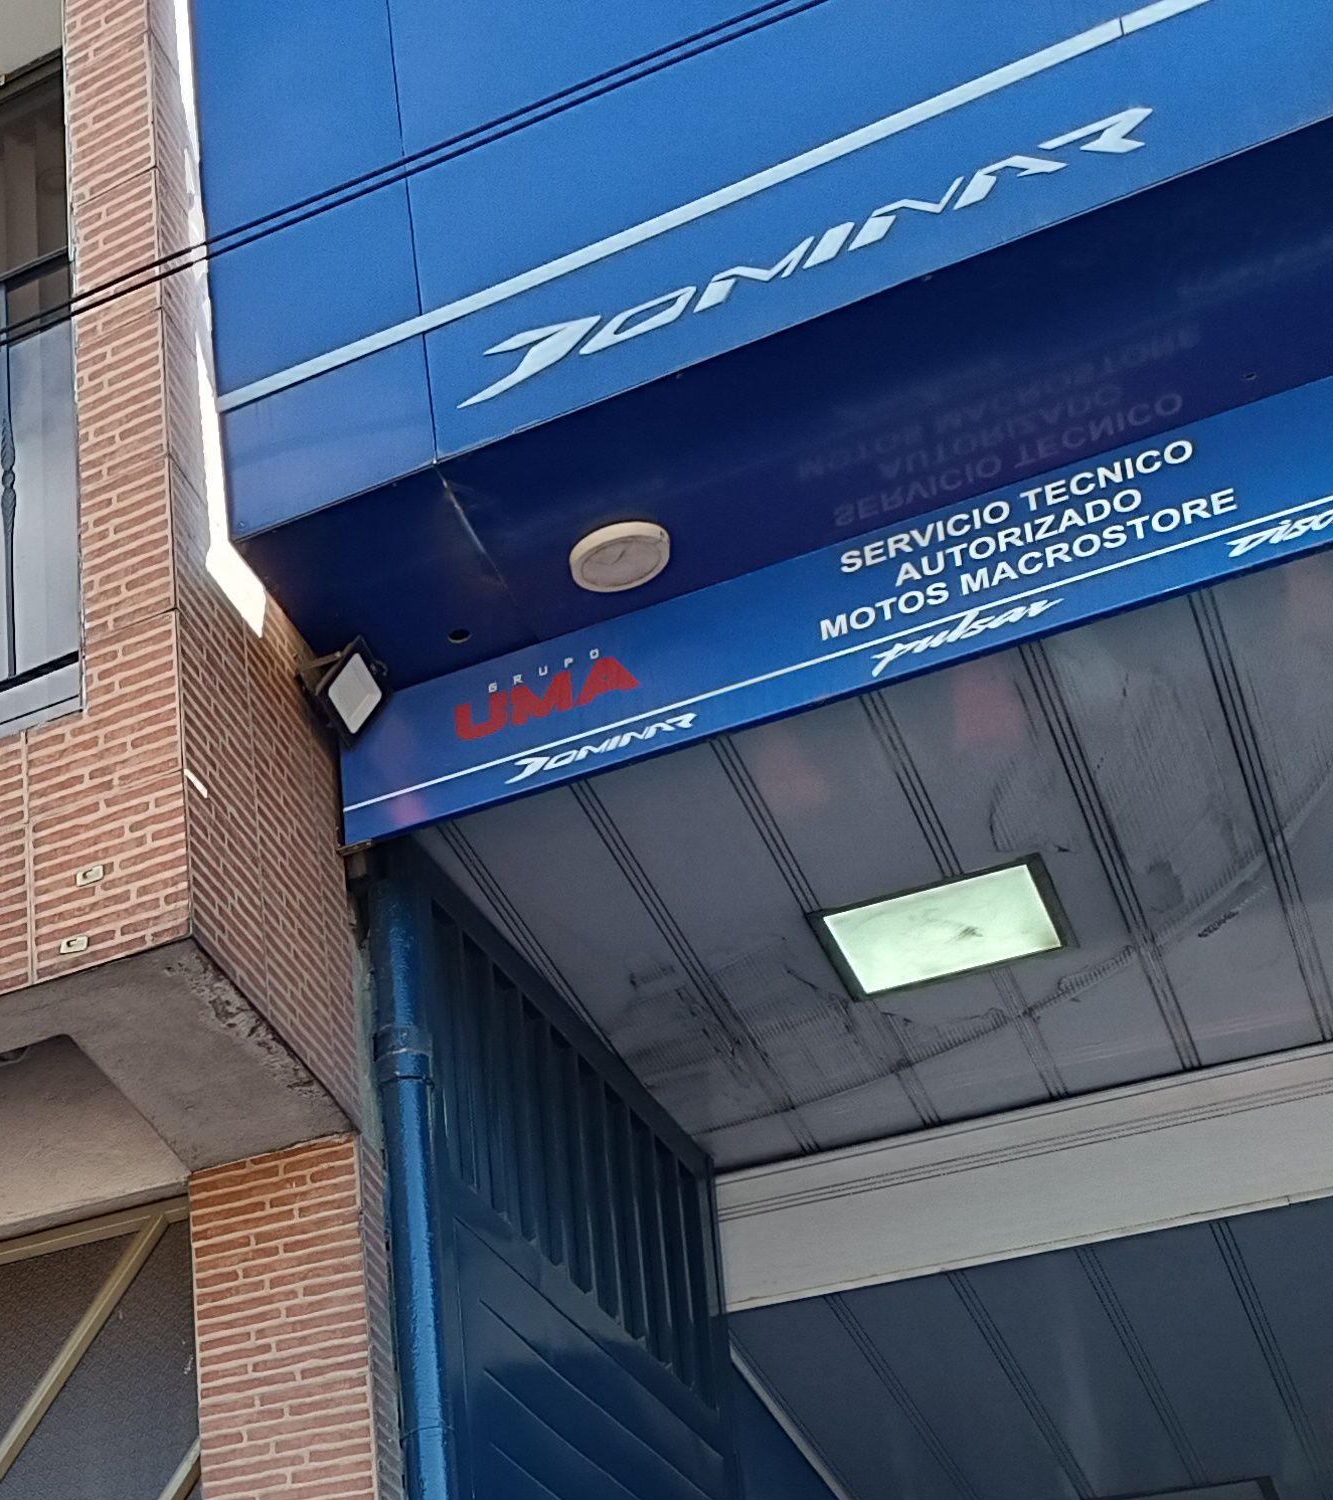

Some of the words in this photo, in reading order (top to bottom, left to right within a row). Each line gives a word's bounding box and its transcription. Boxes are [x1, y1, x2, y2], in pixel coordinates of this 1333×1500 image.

[840, 501, 1010, 574] SERVICIO
[1020, 440, 1194, 511] TECNICO
[895, 488, 1142, 587] AUTORIZADO
[820, 581, 950, 641] MOTOS
[960, 488, 1238, 597] MACROSTORE
[454, 656, 640, 740] UMA
[488, 648, 600, 693] GRUPO
